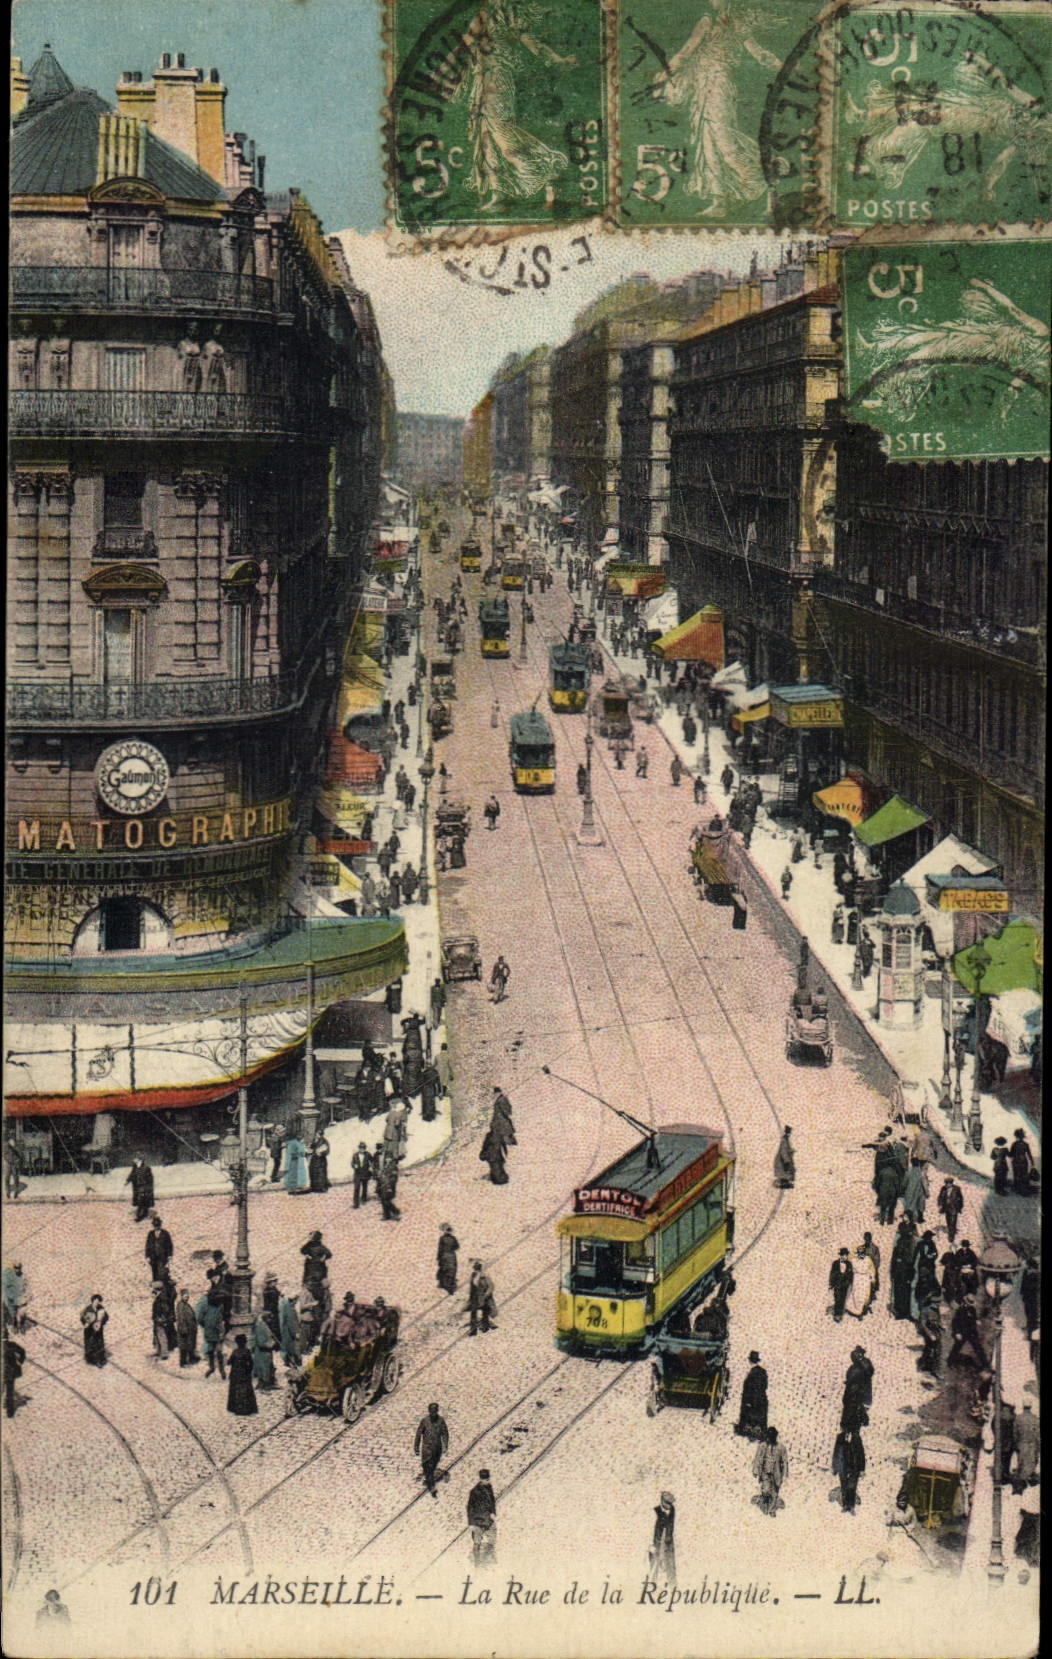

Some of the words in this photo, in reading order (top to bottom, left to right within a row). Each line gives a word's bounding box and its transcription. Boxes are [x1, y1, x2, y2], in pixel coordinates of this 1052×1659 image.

[847, 199, 933, 220] POSTES
[108, 767, 161, 788] Gaumont
[943, 891, 1004, 909] TABACS
[578, 1187, 643, 1208] DENTOL
